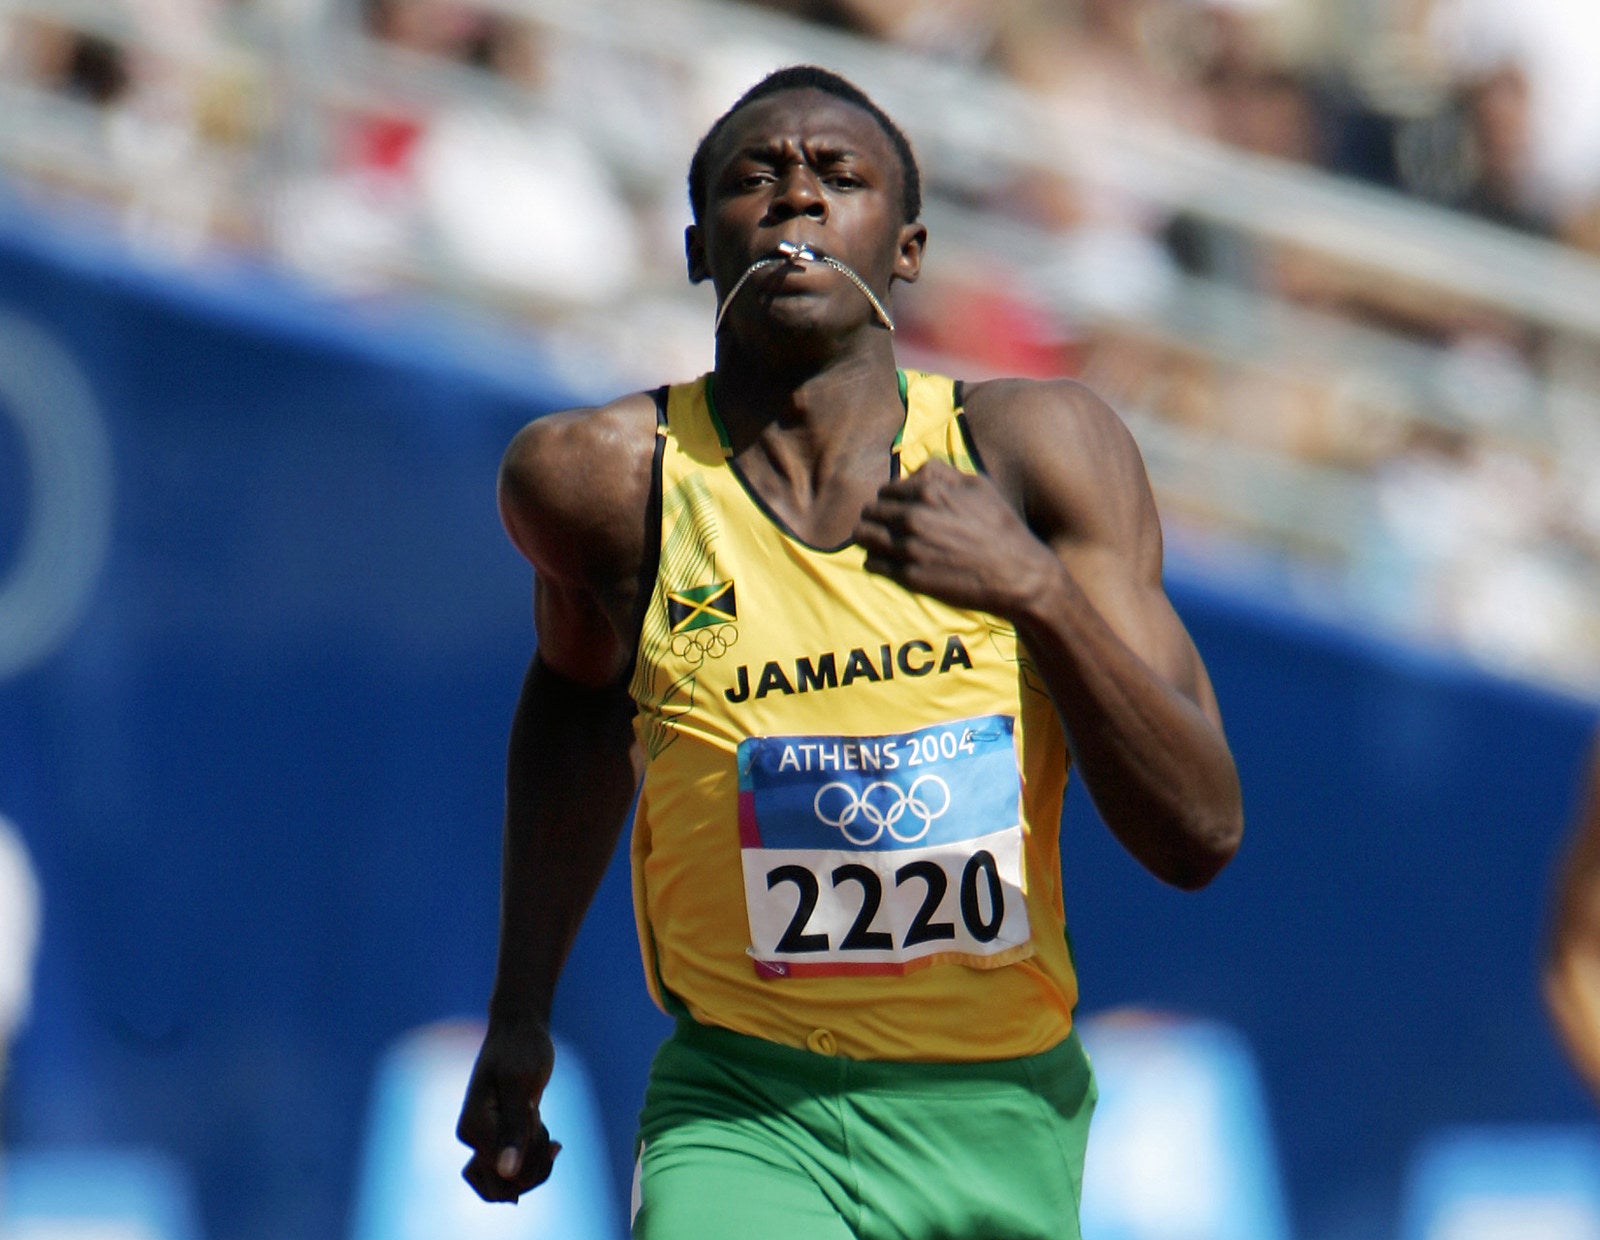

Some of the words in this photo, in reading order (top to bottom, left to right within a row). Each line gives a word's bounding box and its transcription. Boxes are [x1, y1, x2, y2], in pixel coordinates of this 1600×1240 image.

[724, 636, 973, 702] JAMAICA
[778, 741, 900, 772] ATHENS
[906, 727, 975, 767] 2004
[766, 850, 1004, 953] 2220
